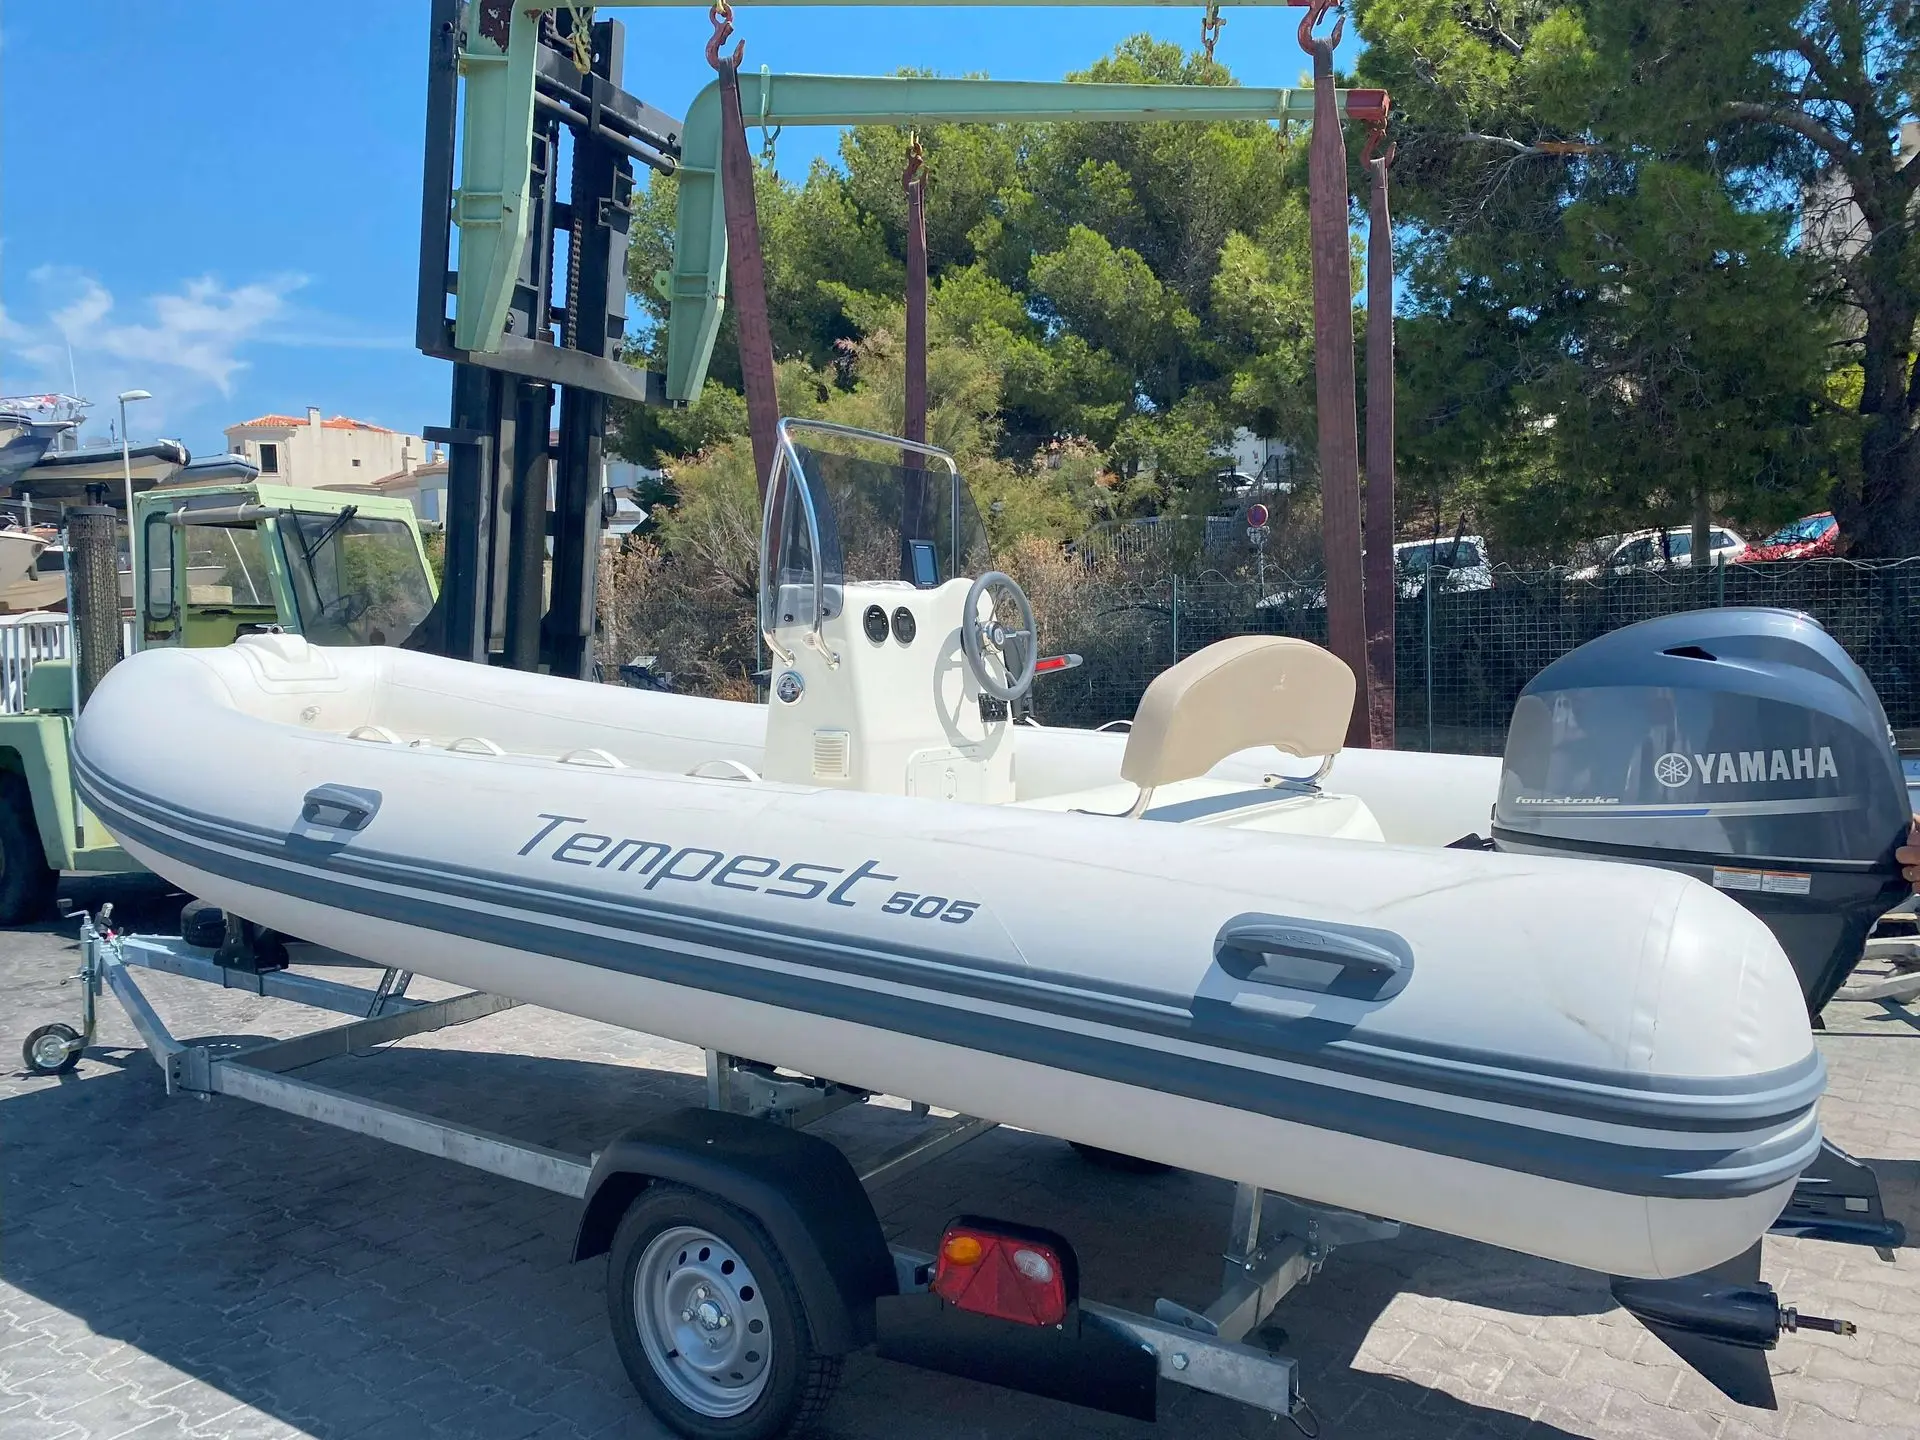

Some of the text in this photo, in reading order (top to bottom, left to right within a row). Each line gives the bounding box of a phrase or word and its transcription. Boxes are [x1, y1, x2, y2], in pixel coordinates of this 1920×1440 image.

[1693, 746, 1839, 785] YAMAHA
[1515, 796, 1620, 805] fourstroke
[517, 813, 982, 924] Tempest 505
